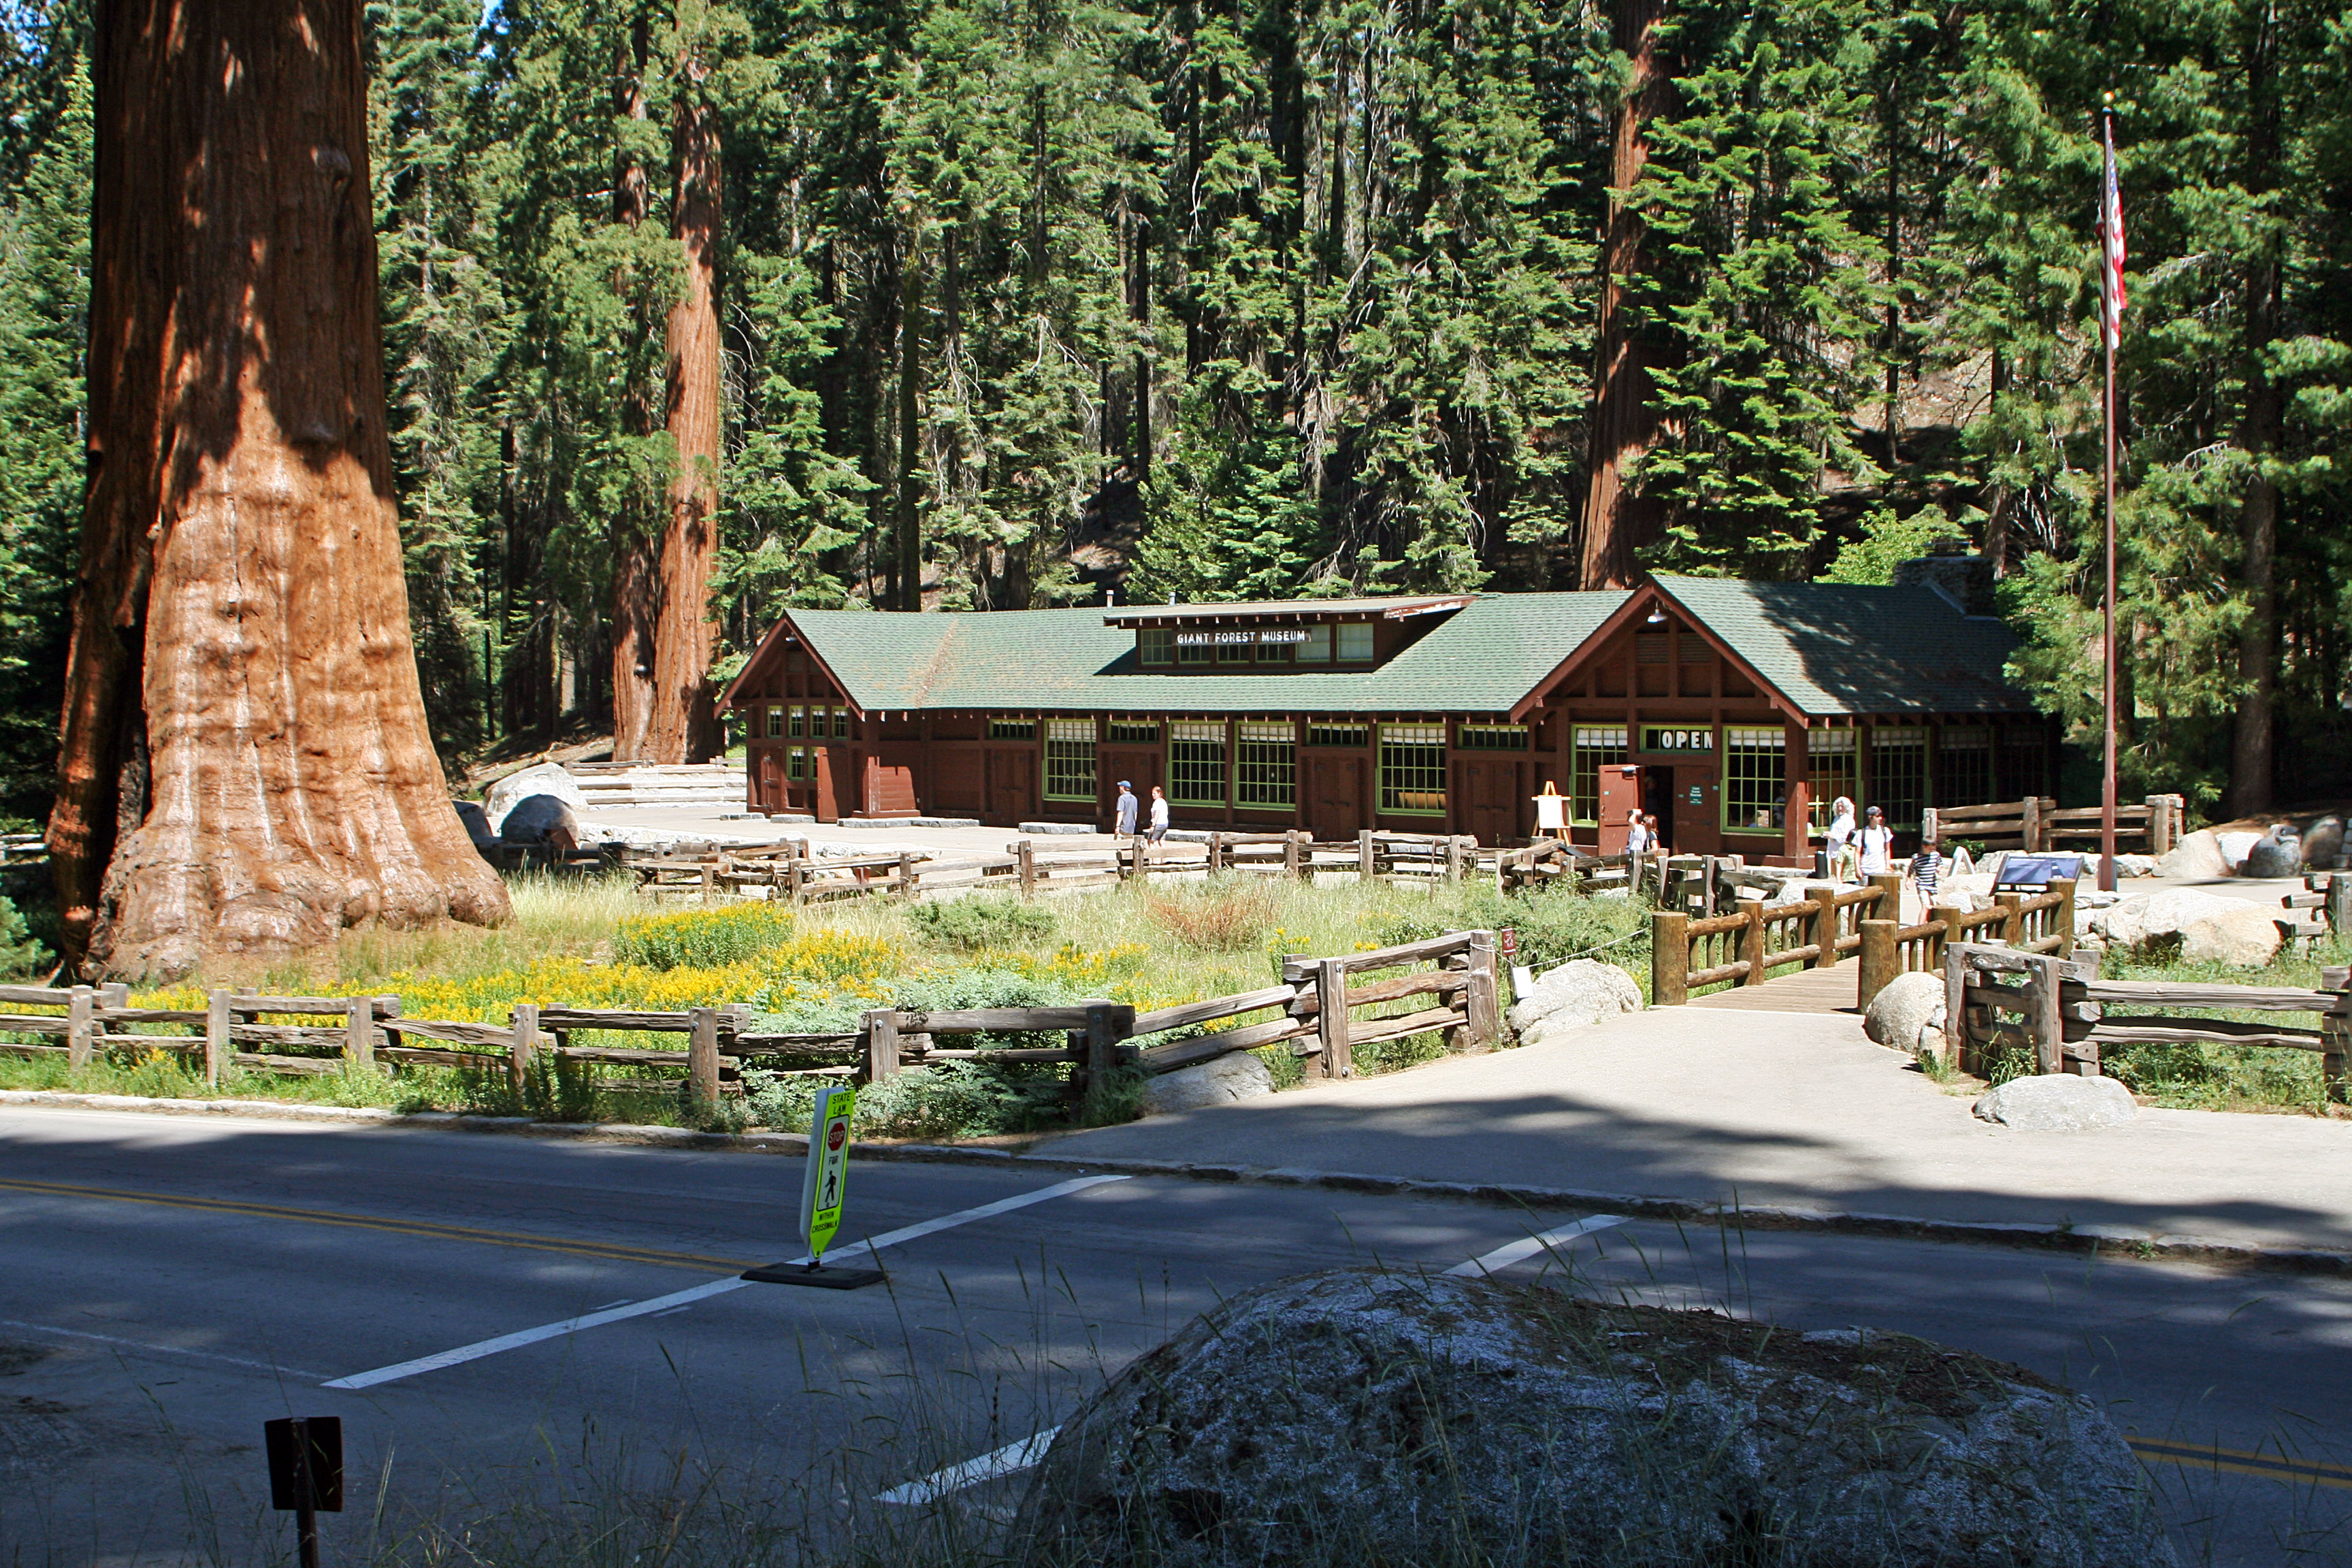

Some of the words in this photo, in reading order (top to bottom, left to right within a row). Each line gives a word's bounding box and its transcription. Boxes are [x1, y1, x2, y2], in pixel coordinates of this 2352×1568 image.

[1177, 633, 1209, 644] GIANT
[1215, 632, 1256, 643] FOREST
[1261, 630, 1305, 642] MUSEUM
[1662, 731, 1713, 749] OPEN
[832, 1092, 851, 1105] STATE
[833, 1104, 847, 1115] LAW
[828, 1130, 845, 1143] STOP
[811, 1220, 838, 1233] CROSSWALK
